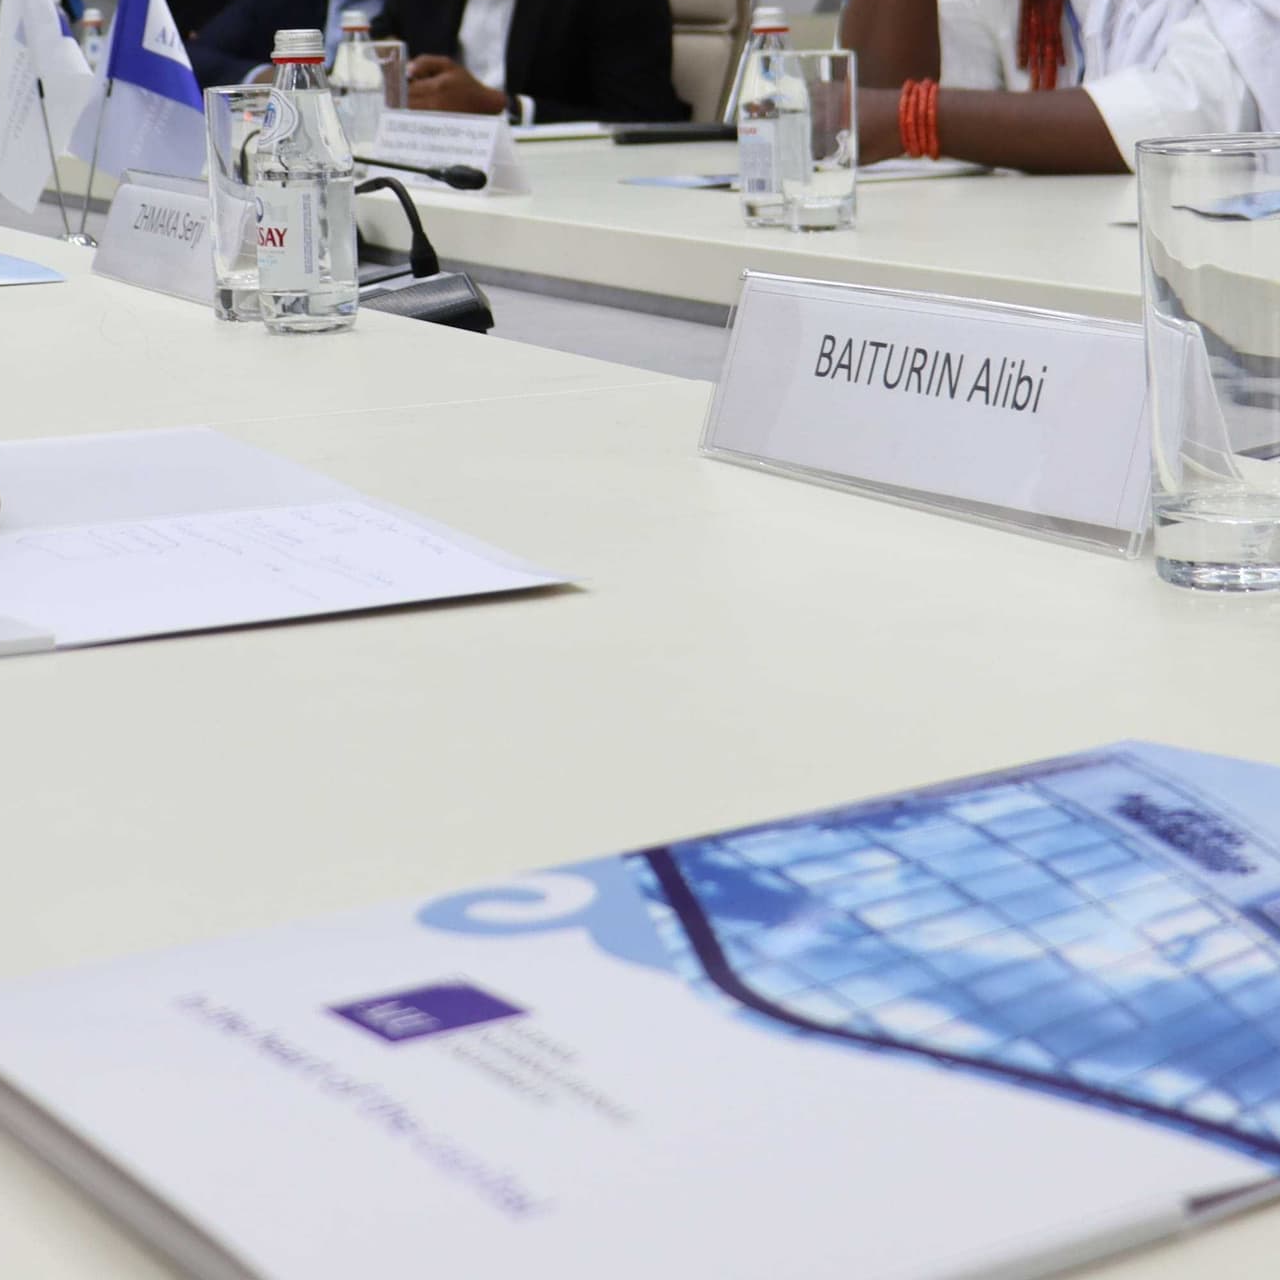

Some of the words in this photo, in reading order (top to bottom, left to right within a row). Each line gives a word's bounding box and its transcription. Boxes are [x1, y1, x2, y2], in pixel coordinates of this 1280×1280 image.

[257, 227, 288, 248] SAY
[814, 334, 965, 400] BAITURIN
[966, 356, 1048, 414] Alibi
